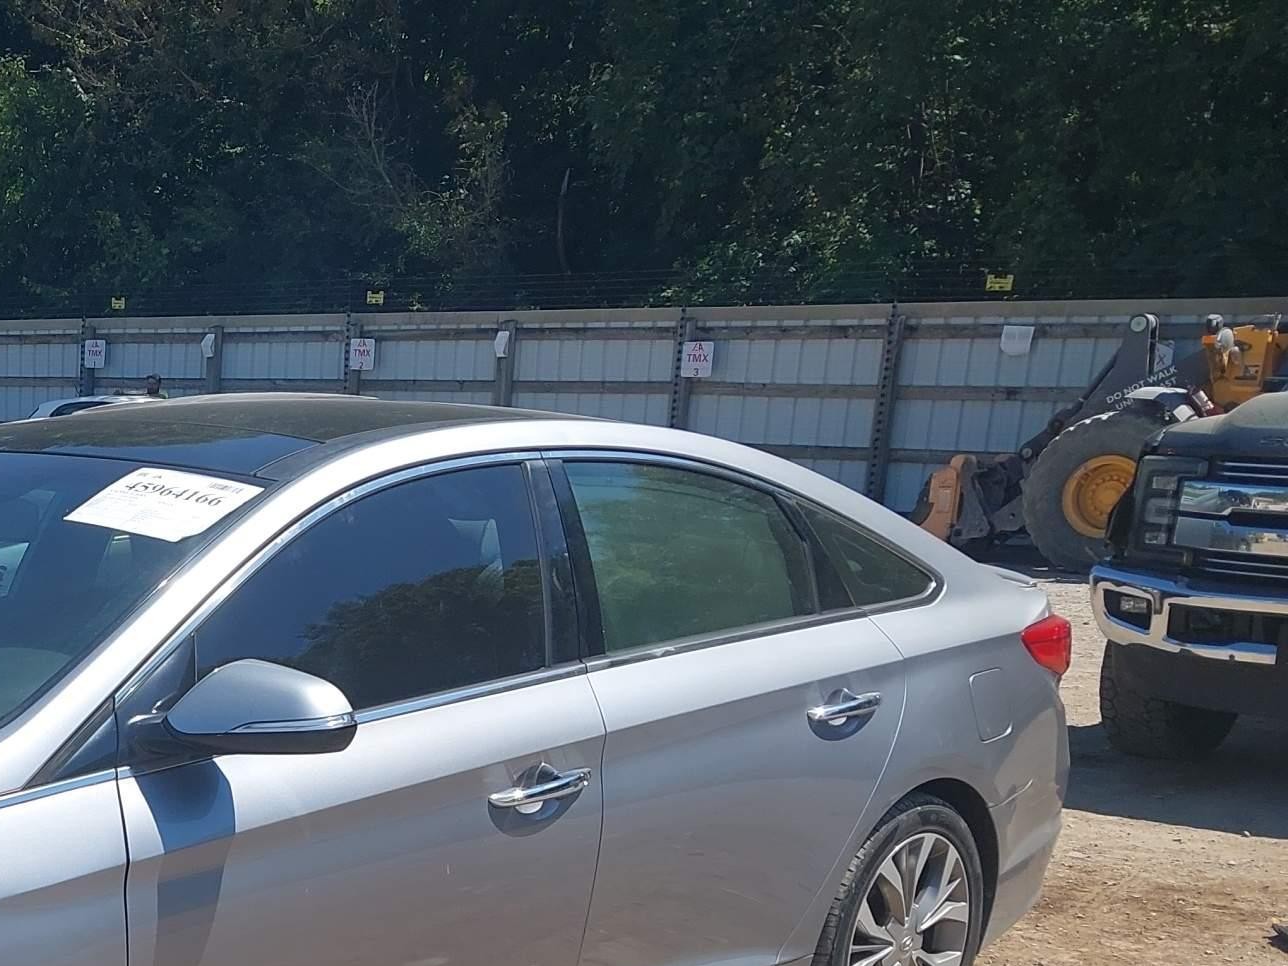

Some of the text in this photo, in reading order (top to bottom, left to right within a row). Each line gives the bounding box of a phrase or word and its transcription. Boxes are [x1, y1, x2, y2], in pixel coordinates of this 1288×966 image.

[353, 348, 372, 357] TMX
[687, 353, 710, 363] TMX
[692, 367, 700, 377] 3
[1106, 364, 1178, 404] DO NOT WALK
[124, 480, 225, 507] 45964166
